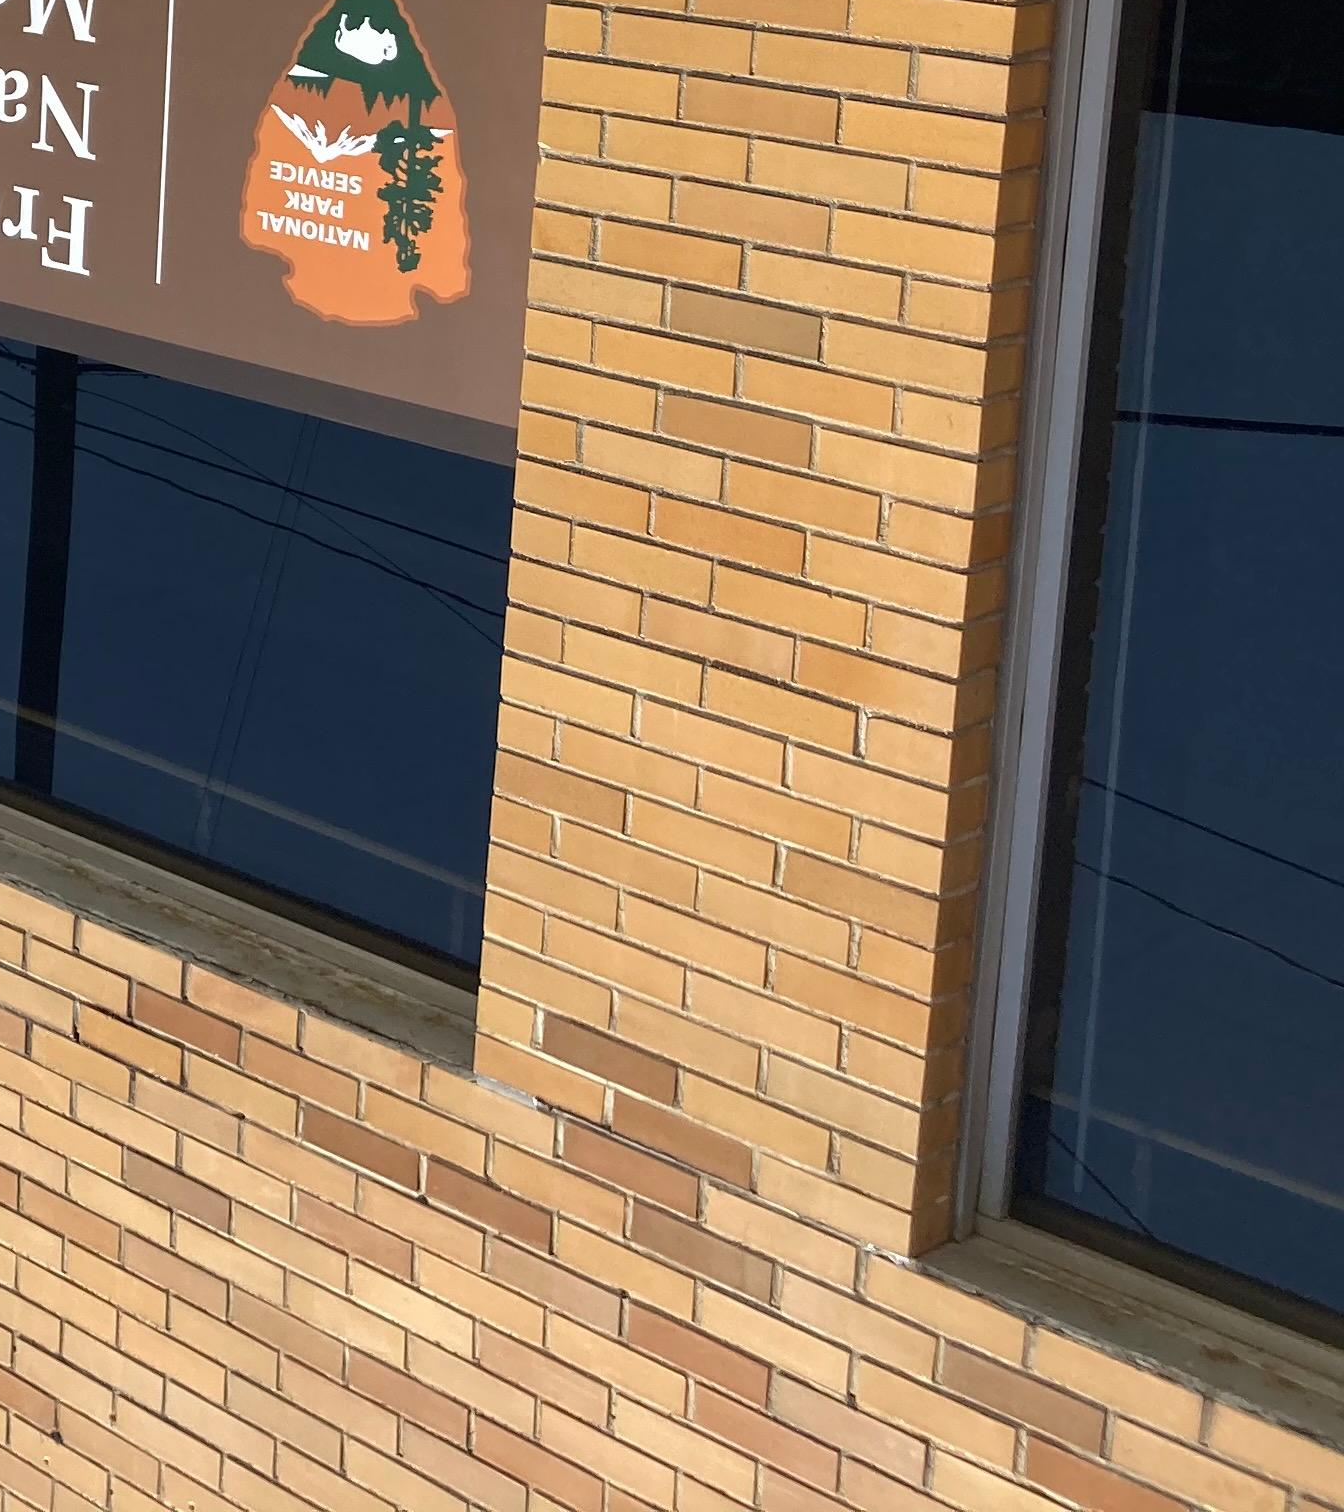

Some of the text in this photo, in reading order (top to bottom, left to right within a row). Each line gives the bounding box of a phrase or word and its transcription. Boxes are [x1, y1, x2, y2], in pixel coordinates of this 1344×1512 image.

[269, 161, 363, 195] SERVICE
[284, 190, 344, 219] PARK
[256, 210, 370, 251] NATIONAL
